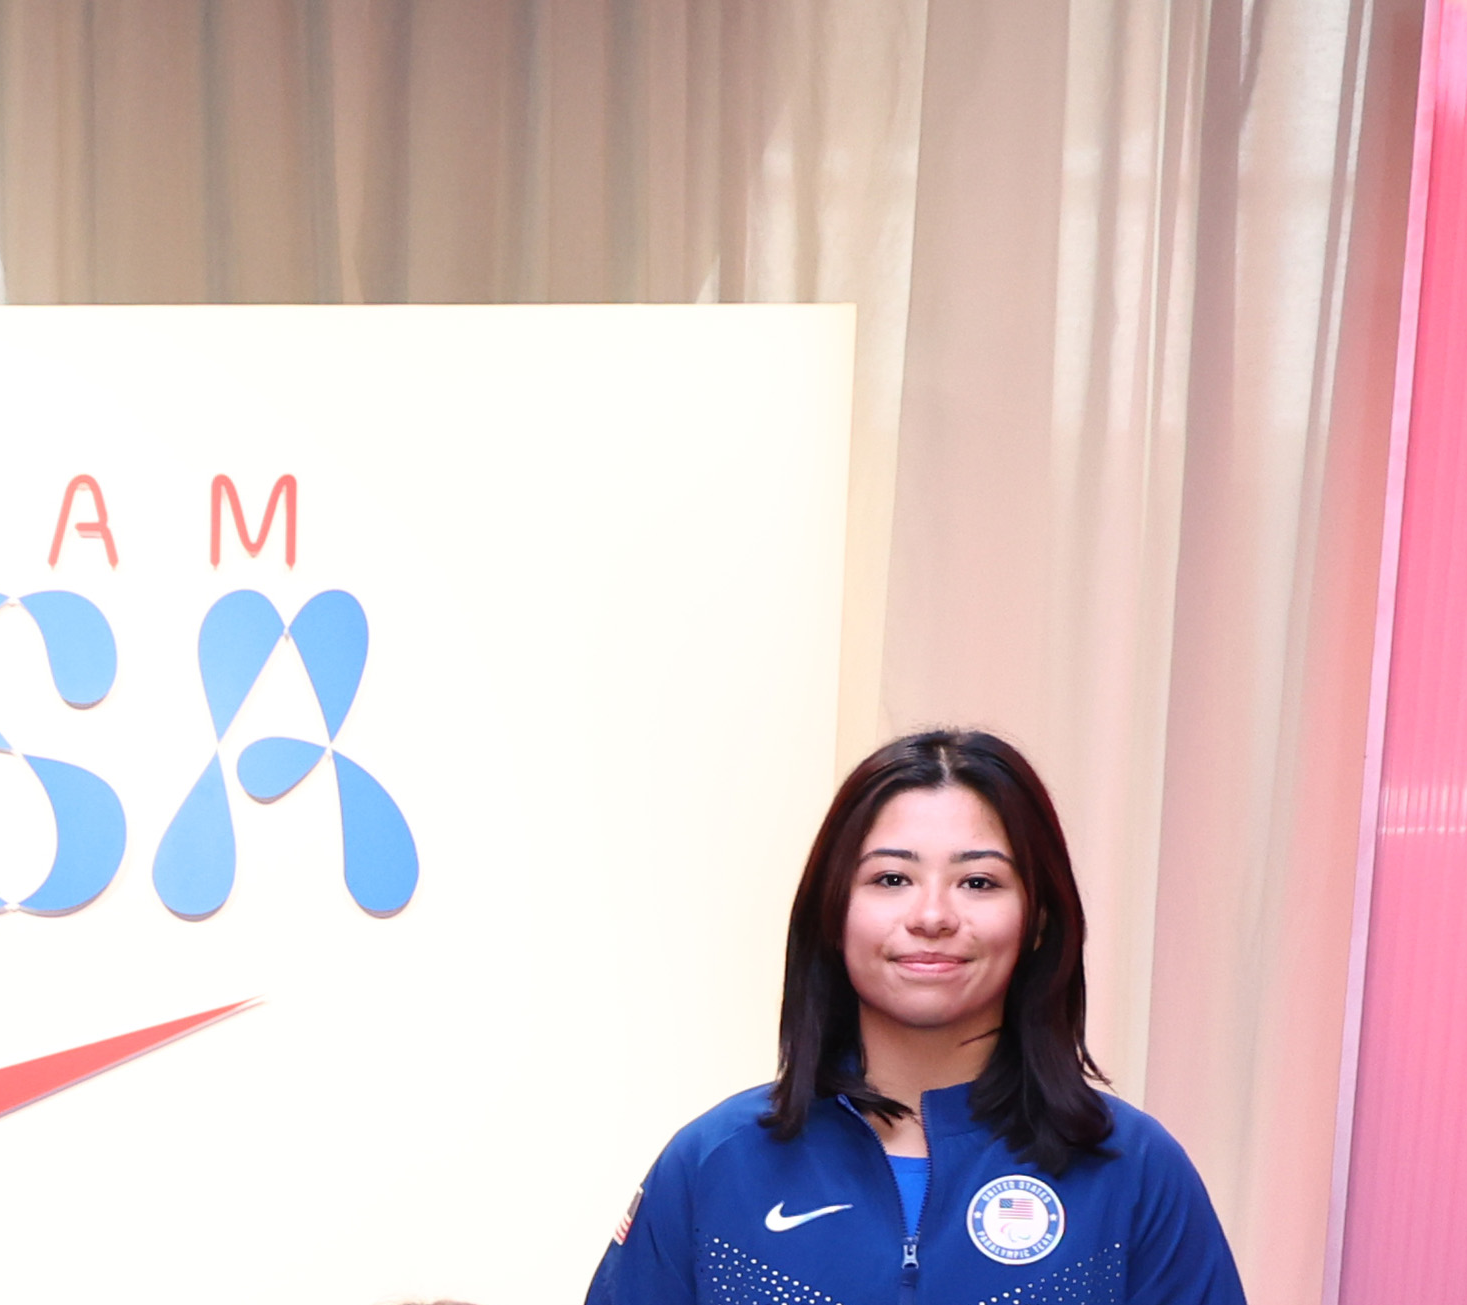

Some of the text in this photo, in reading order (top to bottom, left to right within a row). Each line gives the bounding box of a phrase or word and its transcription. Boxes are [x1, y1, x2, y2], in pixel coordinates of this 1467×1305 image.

[981, 1181, 1052, 1203] UNITED STATES
[976, 1230, 1031, 1258] PARALYMPIC
